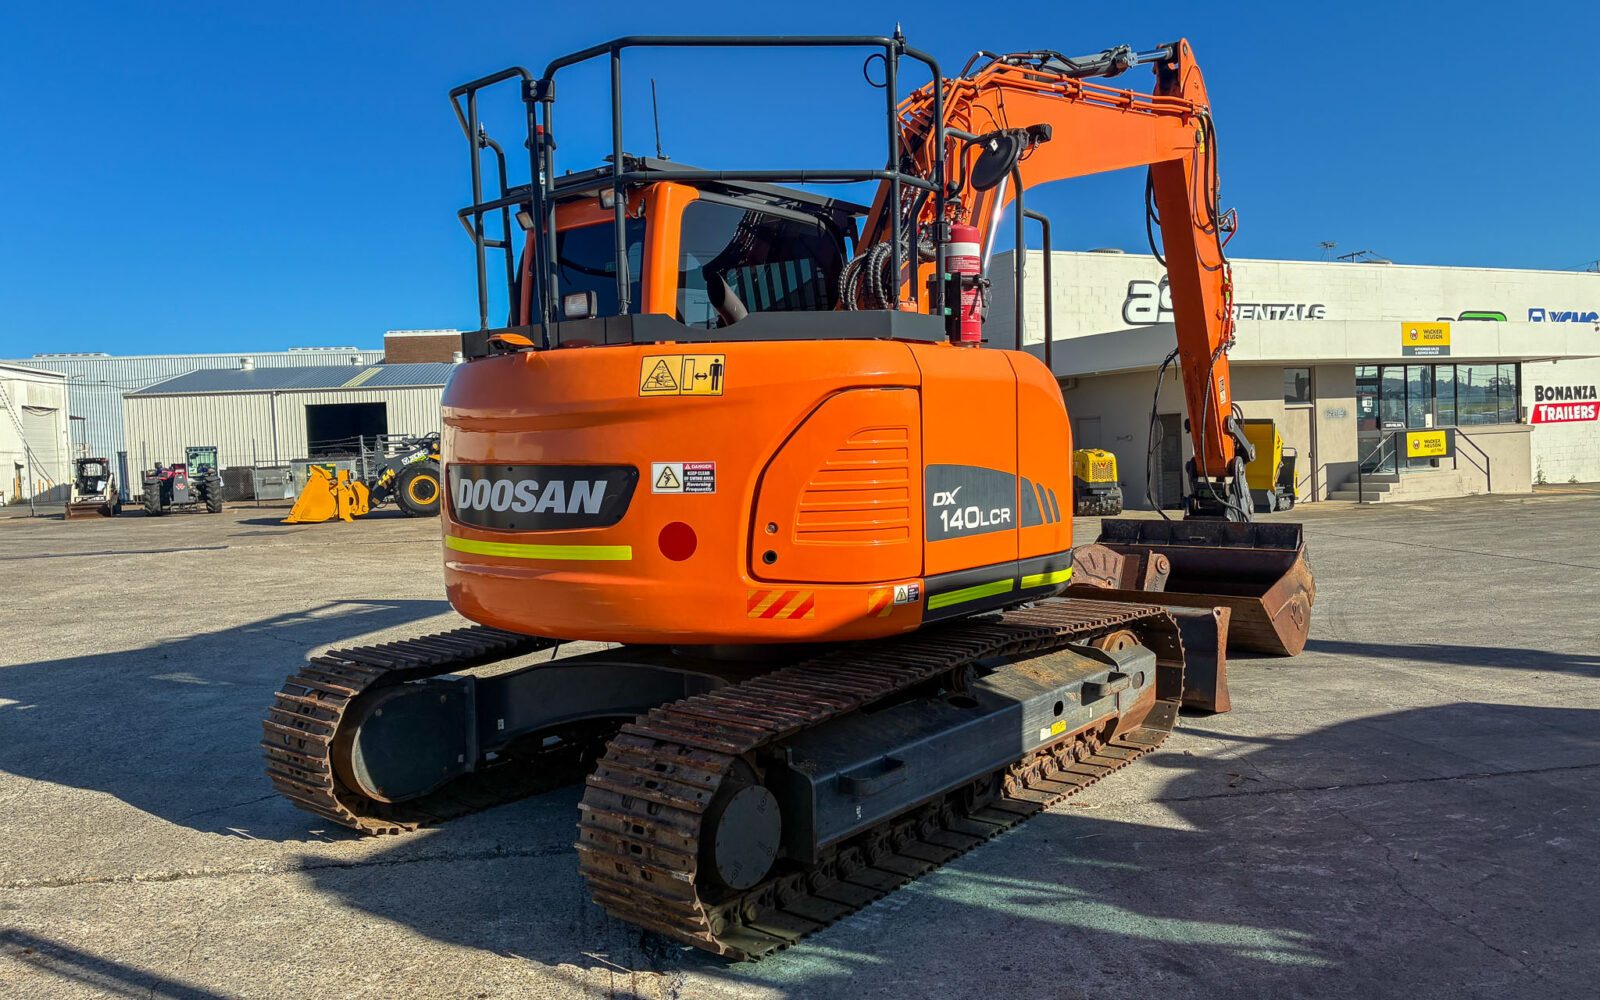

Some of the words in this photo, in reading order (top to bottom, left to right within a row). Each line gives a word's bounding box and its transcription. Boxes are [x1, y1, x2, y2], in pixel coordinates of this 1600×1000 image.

[1534, 385, 1597, 402] BONANZA
[1539, 405, 1595, 421] TRAILERS
[458, 479, 608, 514] DOOSAN
[933, 486, 962, 506] DX
[940, 506, 1011, 532] 140LCR
